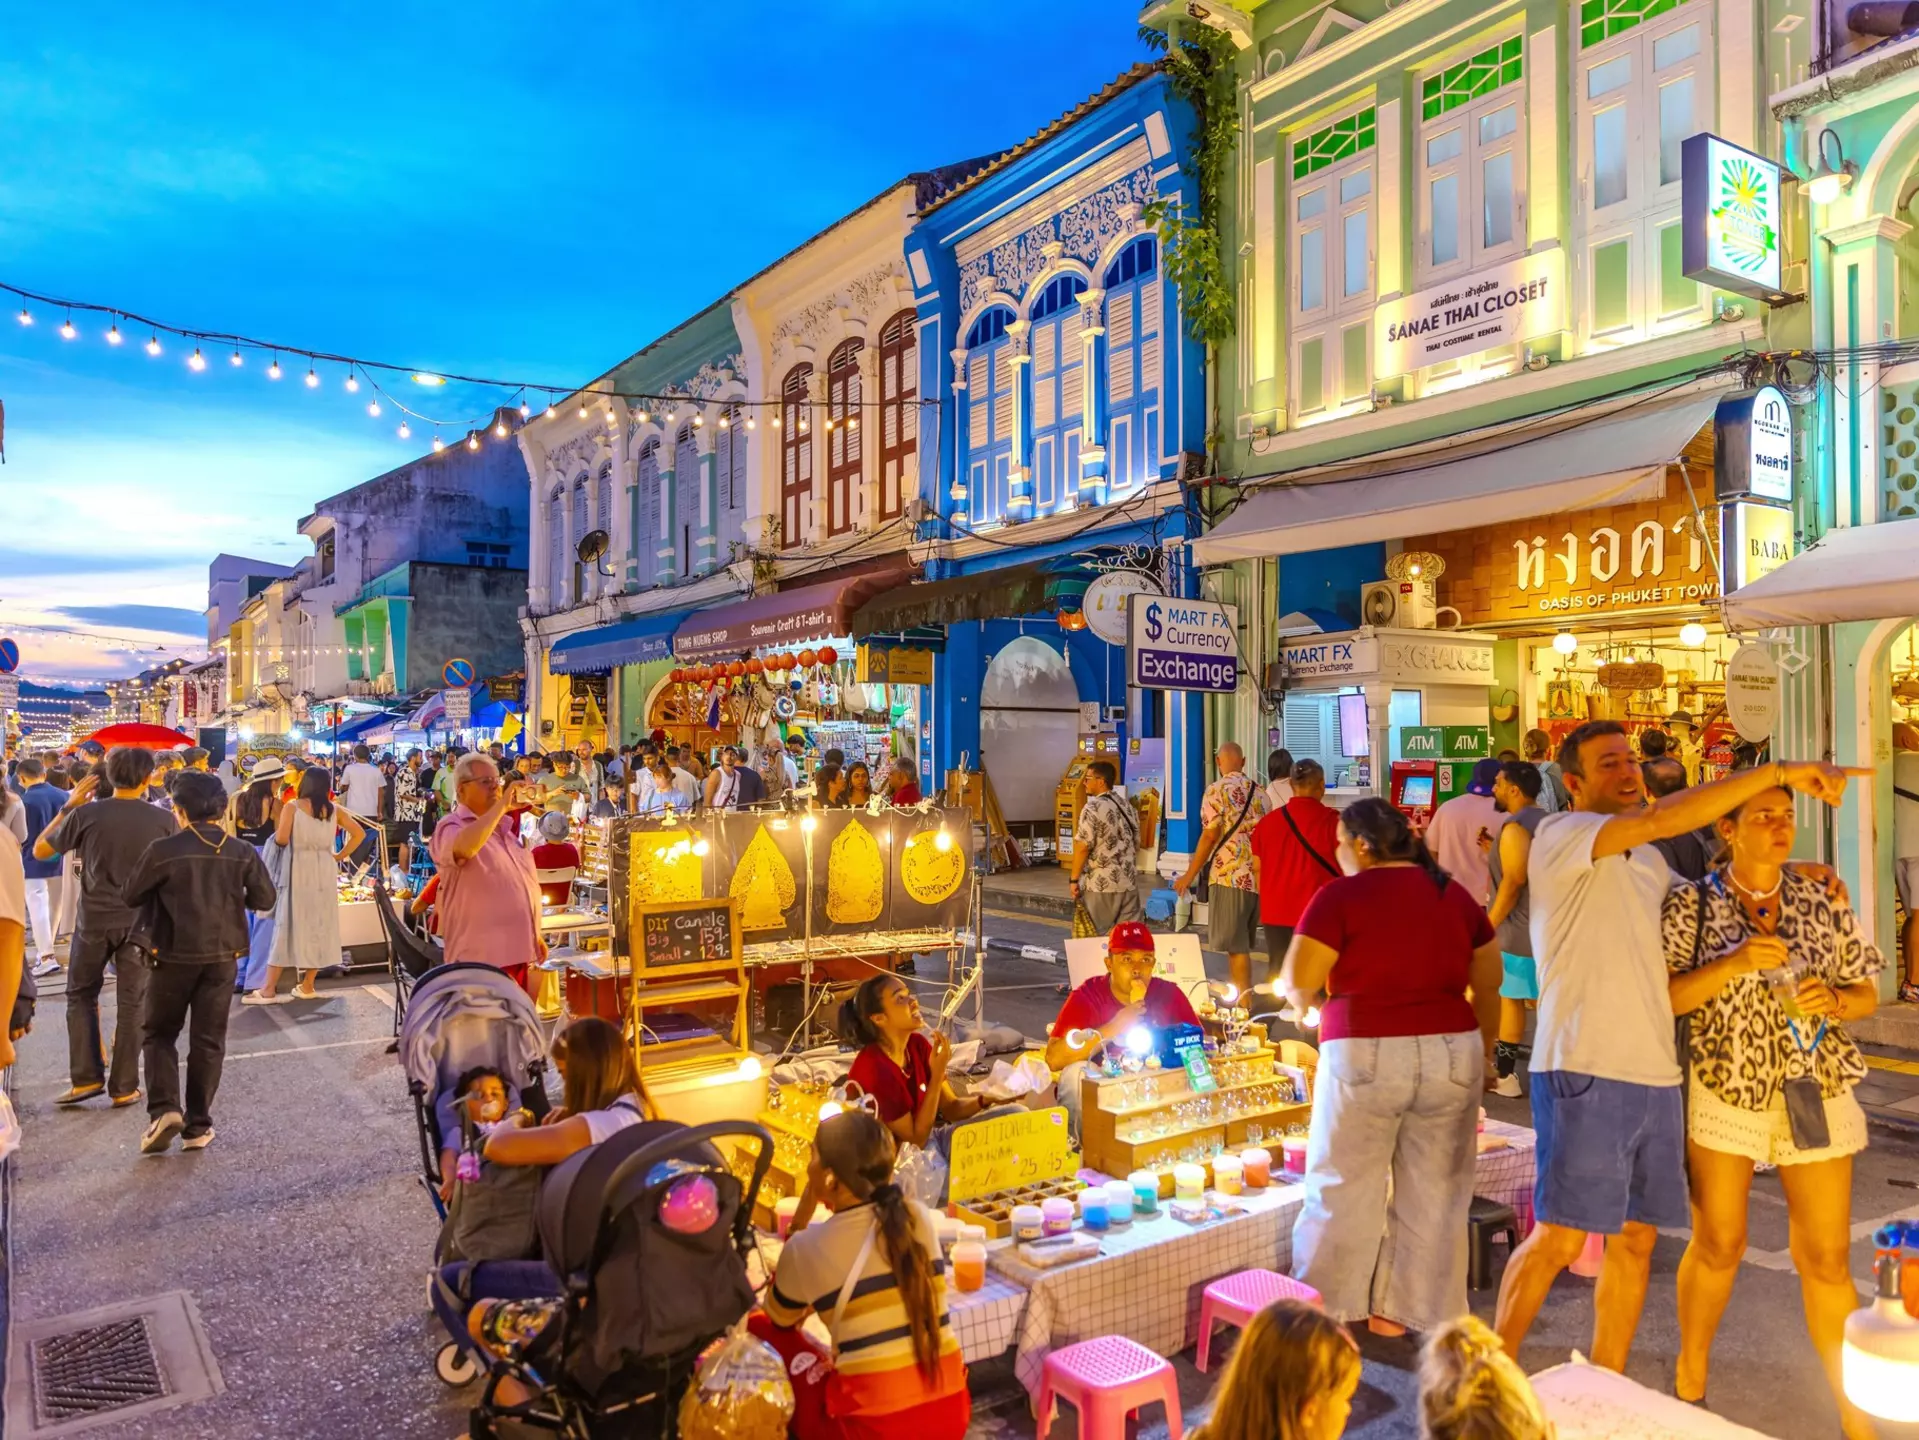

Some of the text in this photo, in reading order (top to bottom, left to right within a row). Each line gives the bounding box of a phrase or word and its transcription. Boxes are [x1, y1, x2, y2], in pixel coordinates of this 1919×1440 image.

[1388, 279, 1548, 342] SANAE THAI CLOSET
[1426, 325, 1503, 352] THAI COSTUME RENTAL
[1750, 539, 1789, 560] BABA
[1539, 595, 1583, 611] OASIS
[1587, 593, 1606, 608] OF
[1612, 586, 1674, 605] PHUKET
[751, 623, 776, 636] Souvenir
[777, 617, 795, 632] Craft
[796, 617, 800, 627] &
[802, 611, 826, 627] T-shirt
[1168, 608, 1208, 626] MART
[1212, 613, 1229, 629] FX
[677, 637, 692, 649] TONG
[692, 633, 711, 647] NUENG
[712, 630, 728, 643] SHOP
[1167, 627, 1230, 652] Currency
[1288, 644, 1352, 664] MART FX
[1142, 653, 1234, 687] Exchange
[1291, 662, 1353, 674] urrency Exchange
[1407, 736, 1434, 750] ATM
[1454, 735, 1478, 750] ATM
[648, 918, 669, 932] DIY
[647, 933, 669, 948] Big
[650, 946, 681, 962] Small
